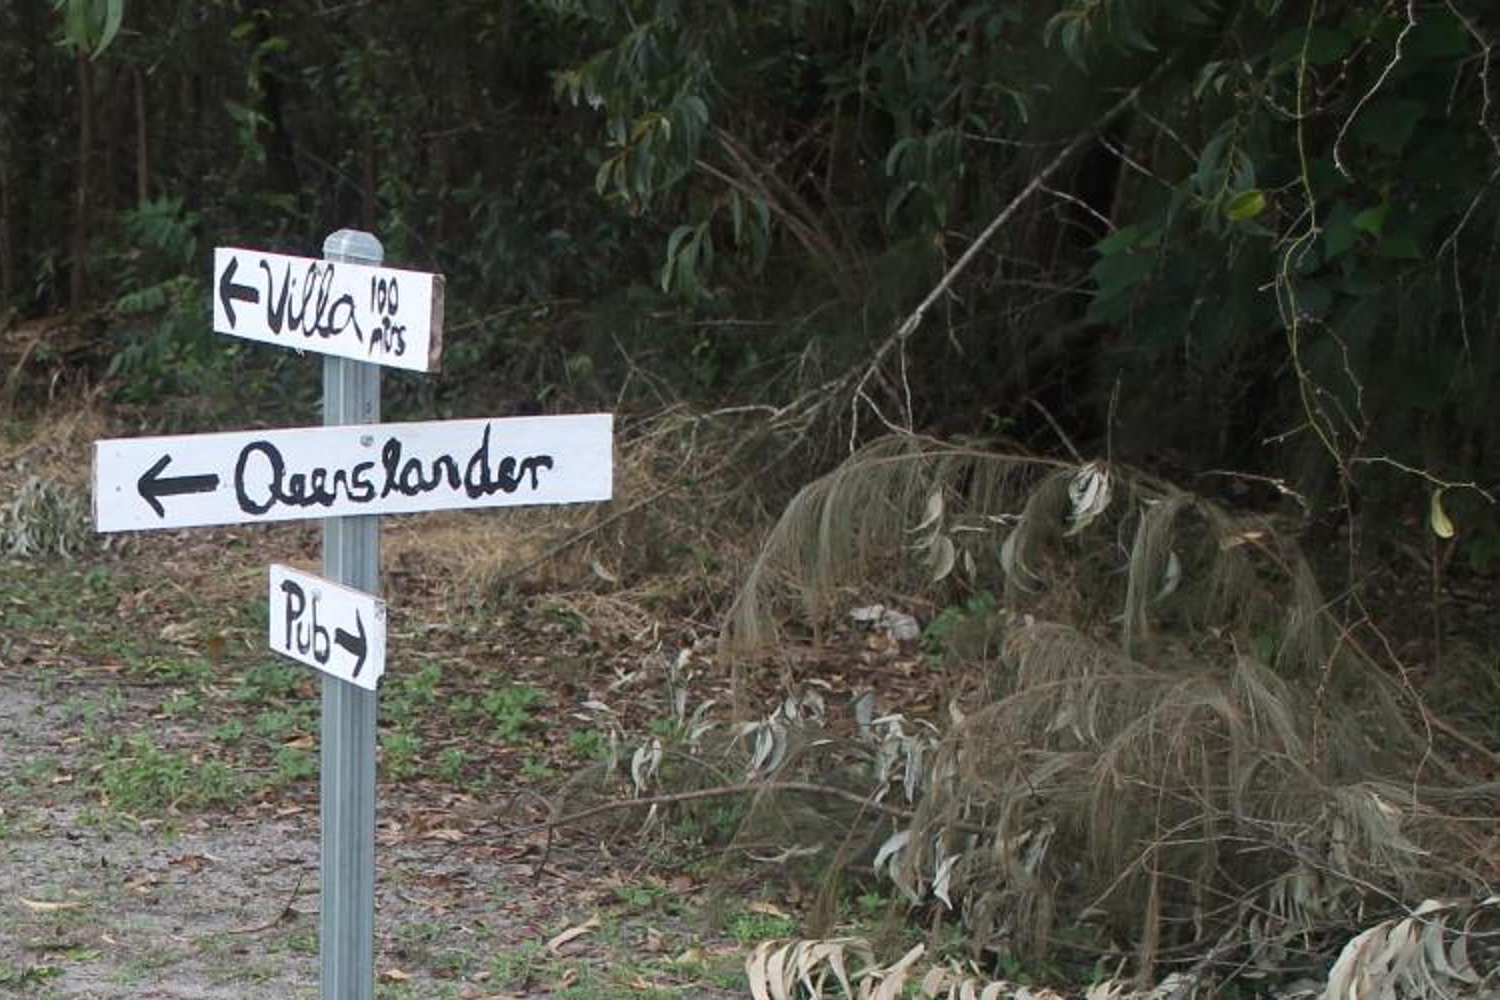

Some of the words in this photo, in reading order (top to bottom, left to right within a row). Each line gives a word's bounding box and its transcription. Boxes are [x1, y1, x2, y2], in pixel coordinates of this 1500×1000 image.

[259, 258, 363, 343] Villa
[370, 275, 399, 315] 100
[280, 579, 331, 665] Pub
